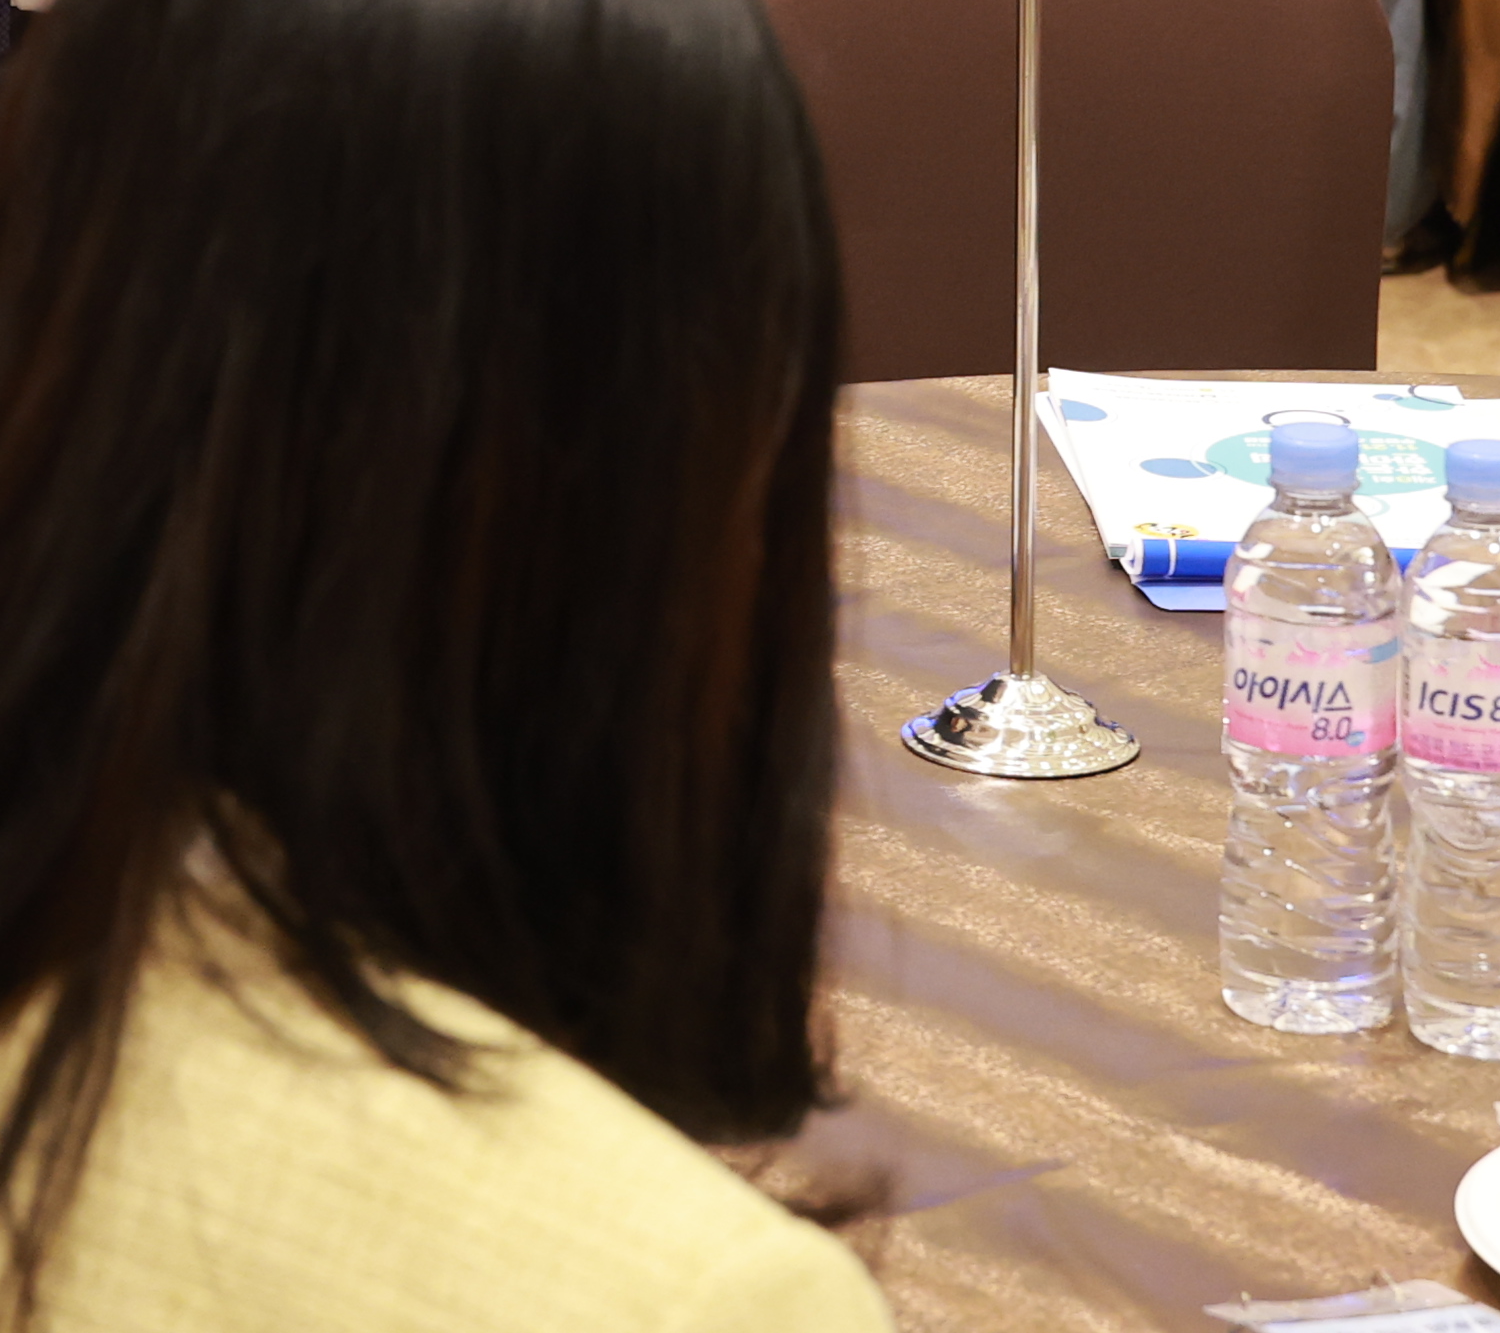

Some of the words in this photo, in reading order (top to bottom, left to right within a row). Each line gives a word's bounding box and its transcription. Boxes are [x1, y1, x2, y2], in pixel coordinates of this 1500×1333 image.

[1233, 668, 1353, 712] 아이시스
[1419, 681, 1484, 721] ICIS
[1311, 717, 1352, 741] 8.0
